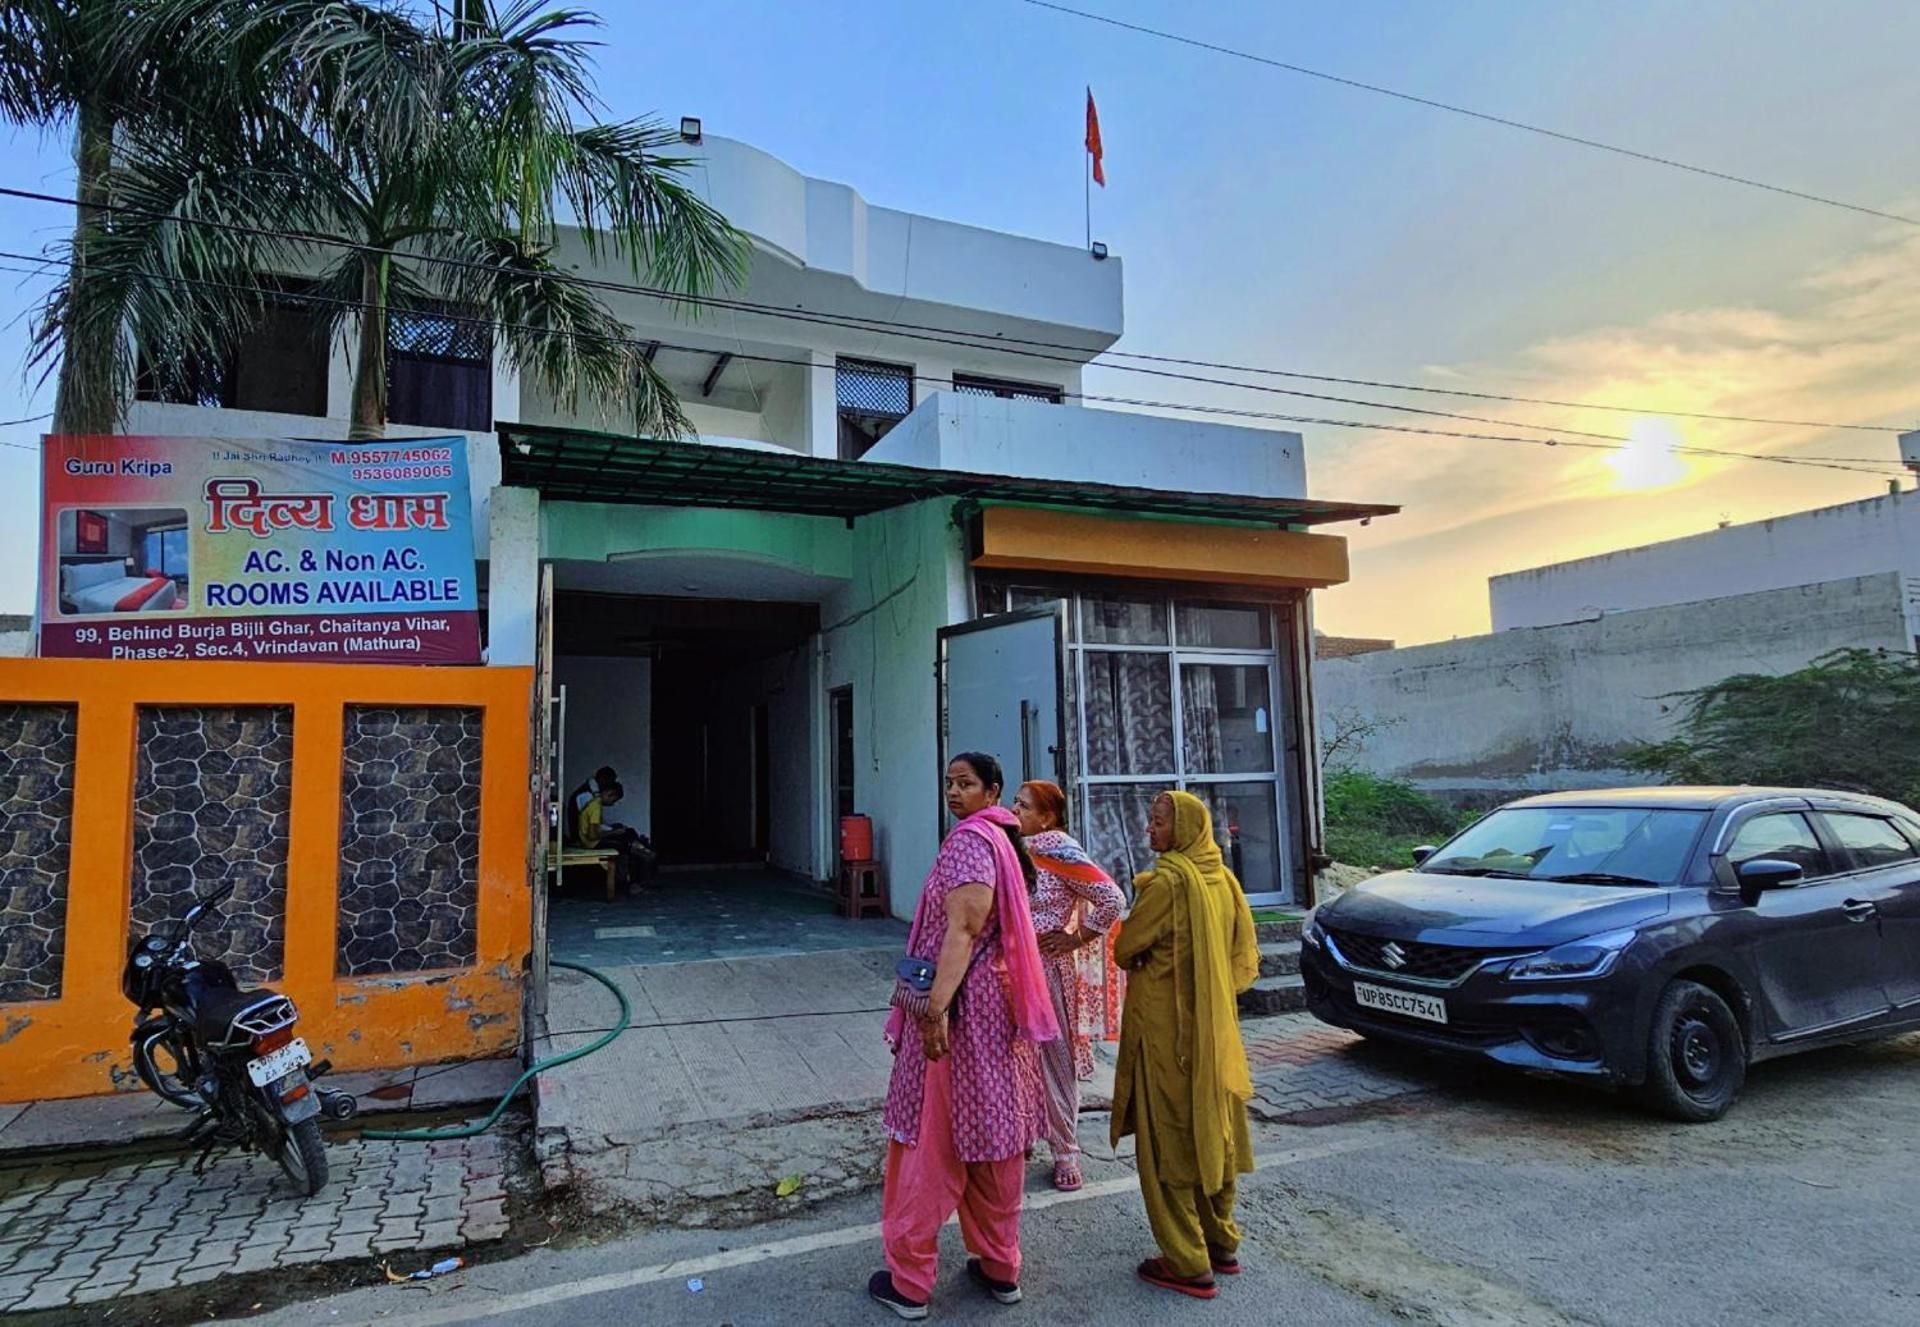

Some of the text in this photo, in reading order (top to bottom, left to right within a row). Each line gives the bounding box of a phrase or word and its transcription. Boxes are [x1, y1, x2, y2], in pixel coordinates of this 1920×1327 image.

[65, 458, 172, 478] Guru Kripa
[330, 448, 451, 464] M.9557745062
[351, 464, 452, 480] 9536089065
[204, 478, 449, 536] दिव्य धाम
[243, 548, 425, 573] AC. & Non AC.
[206, 579, 460, 607] ROOMS AVAILABLE
[75, 617, 451, 645] 99, Behind Burja Bijli Ghar, Chaitanya Vihar,
[111, 636, 421, 660] Phase-2, Sec.4, Vrindavan (Mathura)
[1363, 988, 1443, 1018] UP85CC7541
